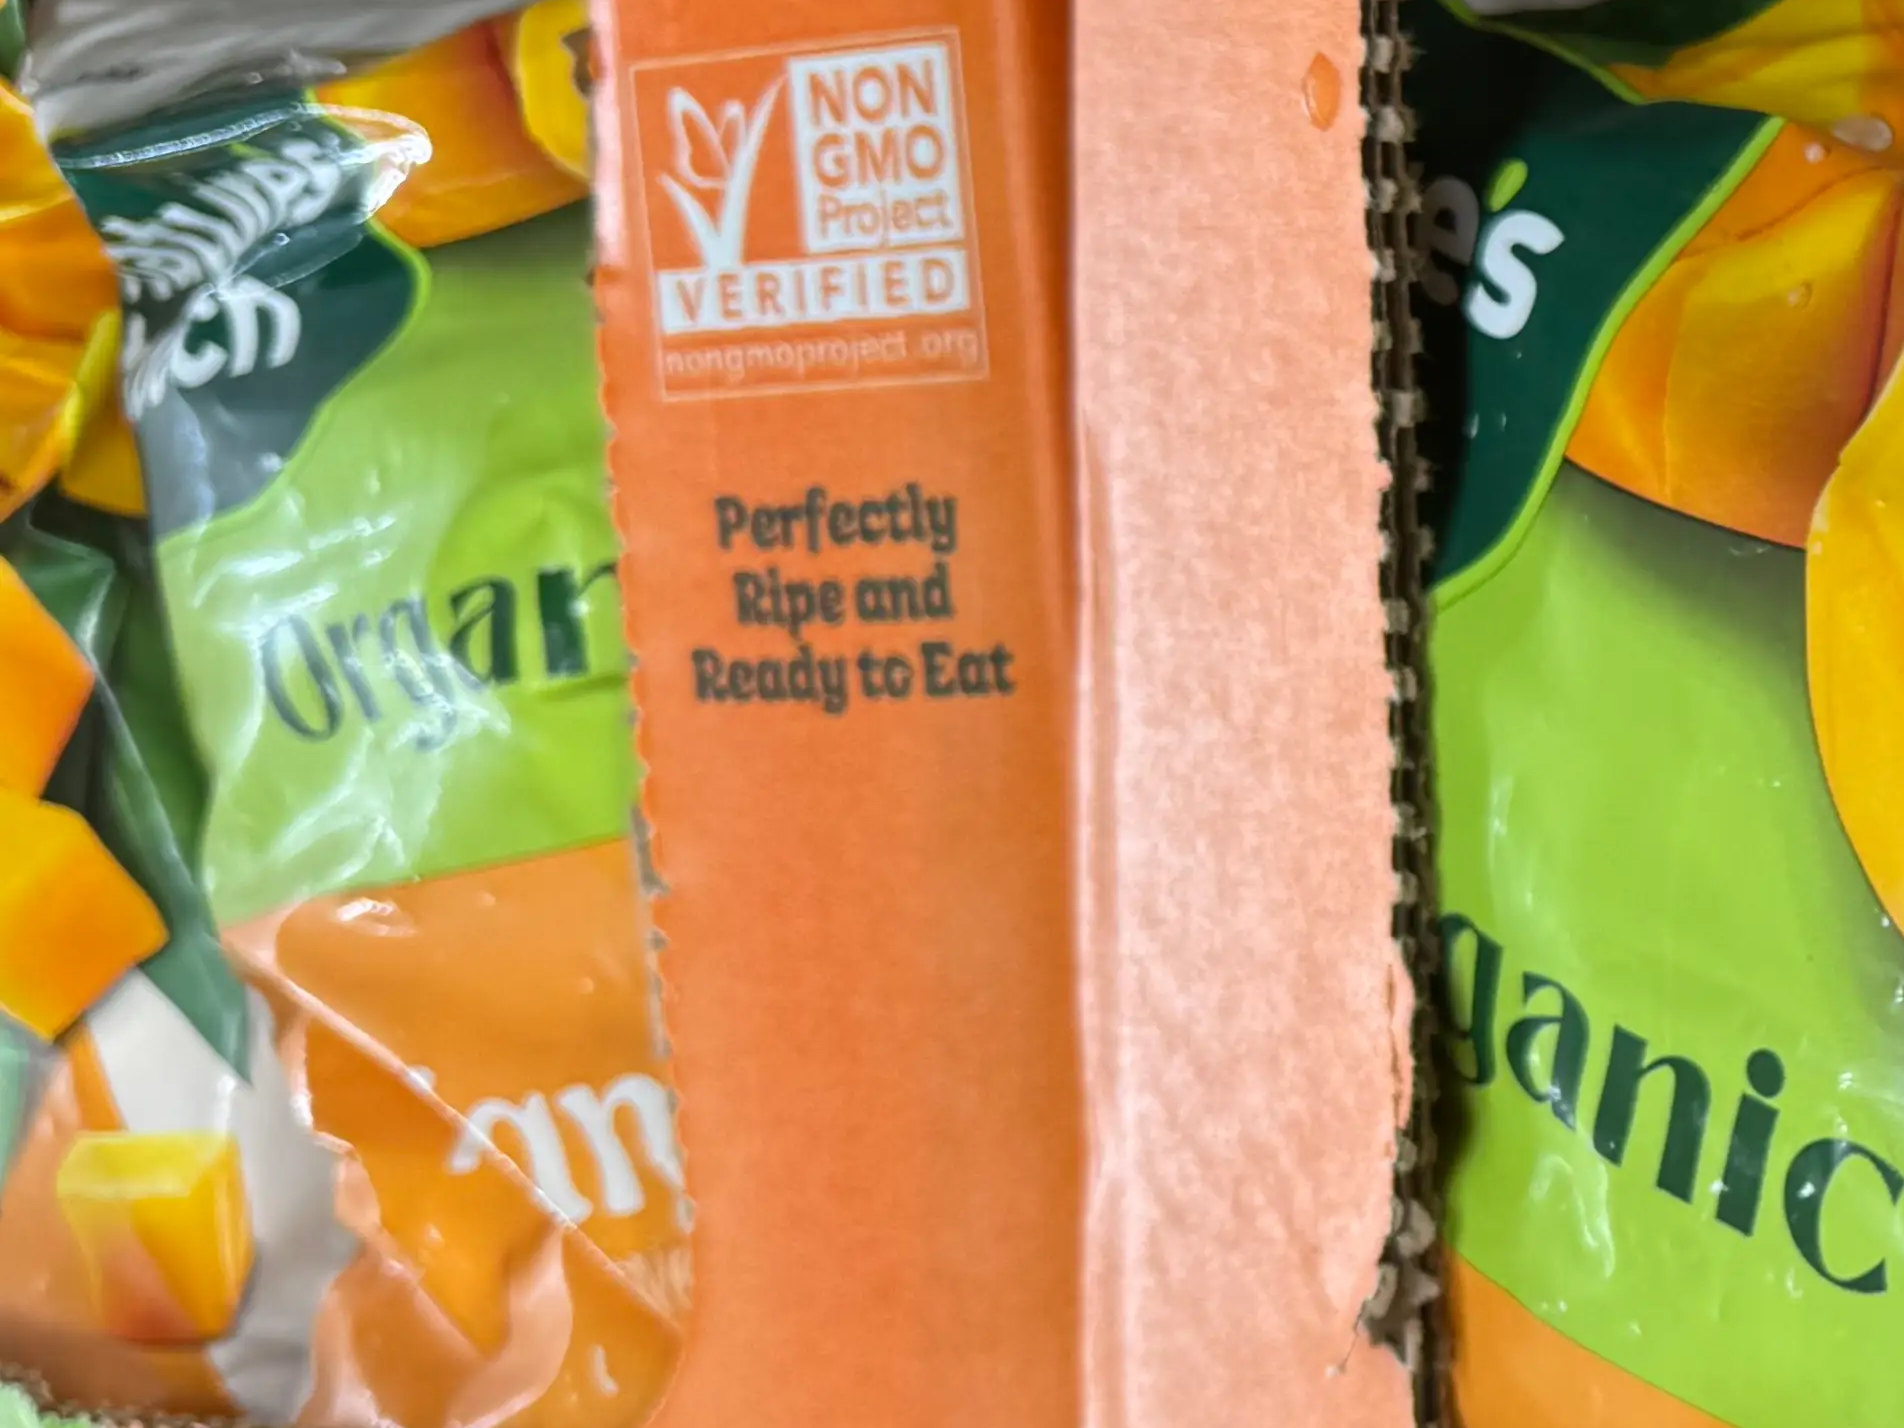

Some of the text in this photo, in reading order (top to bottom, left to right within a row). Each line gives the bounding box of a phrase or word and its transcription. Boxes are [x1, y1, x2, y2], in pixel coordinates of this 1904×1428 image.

[808, 60, 938, 125] NON
[811, 124, 943, 187] GMO
[816, 189, 952, 247] Project
[677, 258, 955, 321] VERIFIED
[715, 482, 956, 555] Perfectly
[733, 563, 954, 642] Ripe and
[692, 639, 1015, 714] Ready to Eat
